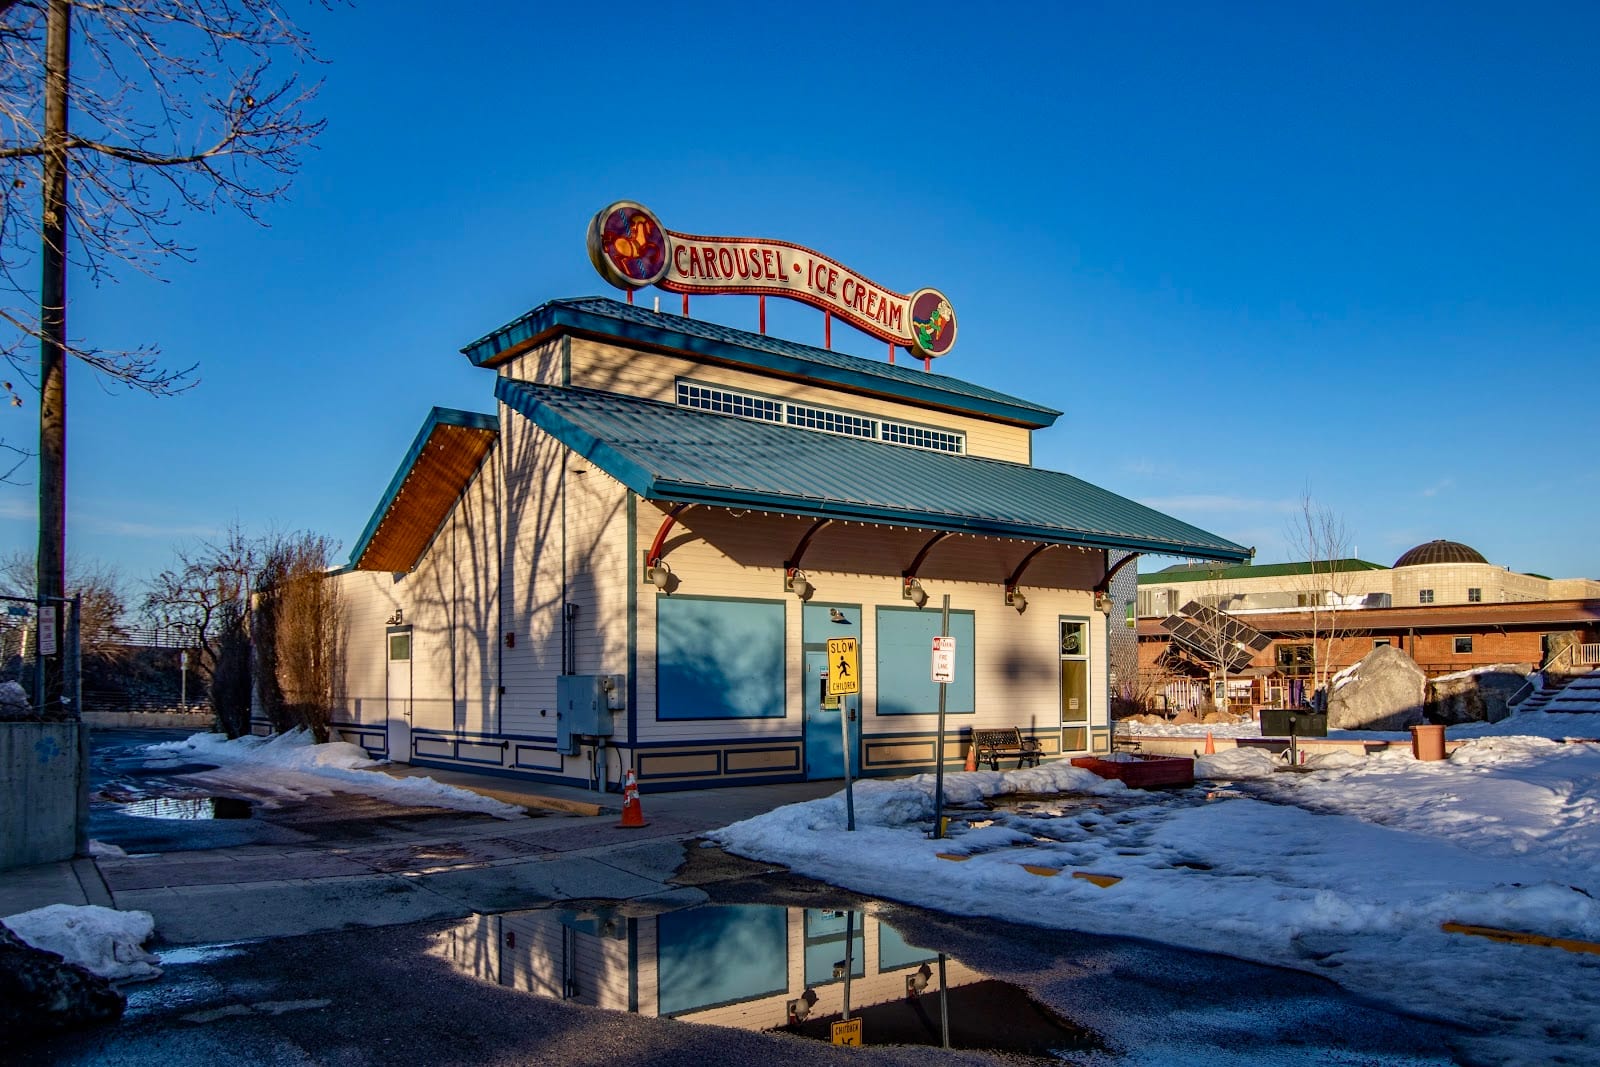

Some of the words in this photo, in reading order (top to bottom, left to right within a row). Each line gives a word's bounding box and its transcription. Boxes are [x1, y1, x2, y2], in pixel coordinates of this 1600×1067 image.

[674, 244, 789, 282] CAROUSEL
[808, 259, 838, 299] ICE
[842, 278, 902, 332] CREAM
[831, 642, 854, 654] SLOW
[832, 681, 855, 691] CHILDREN
